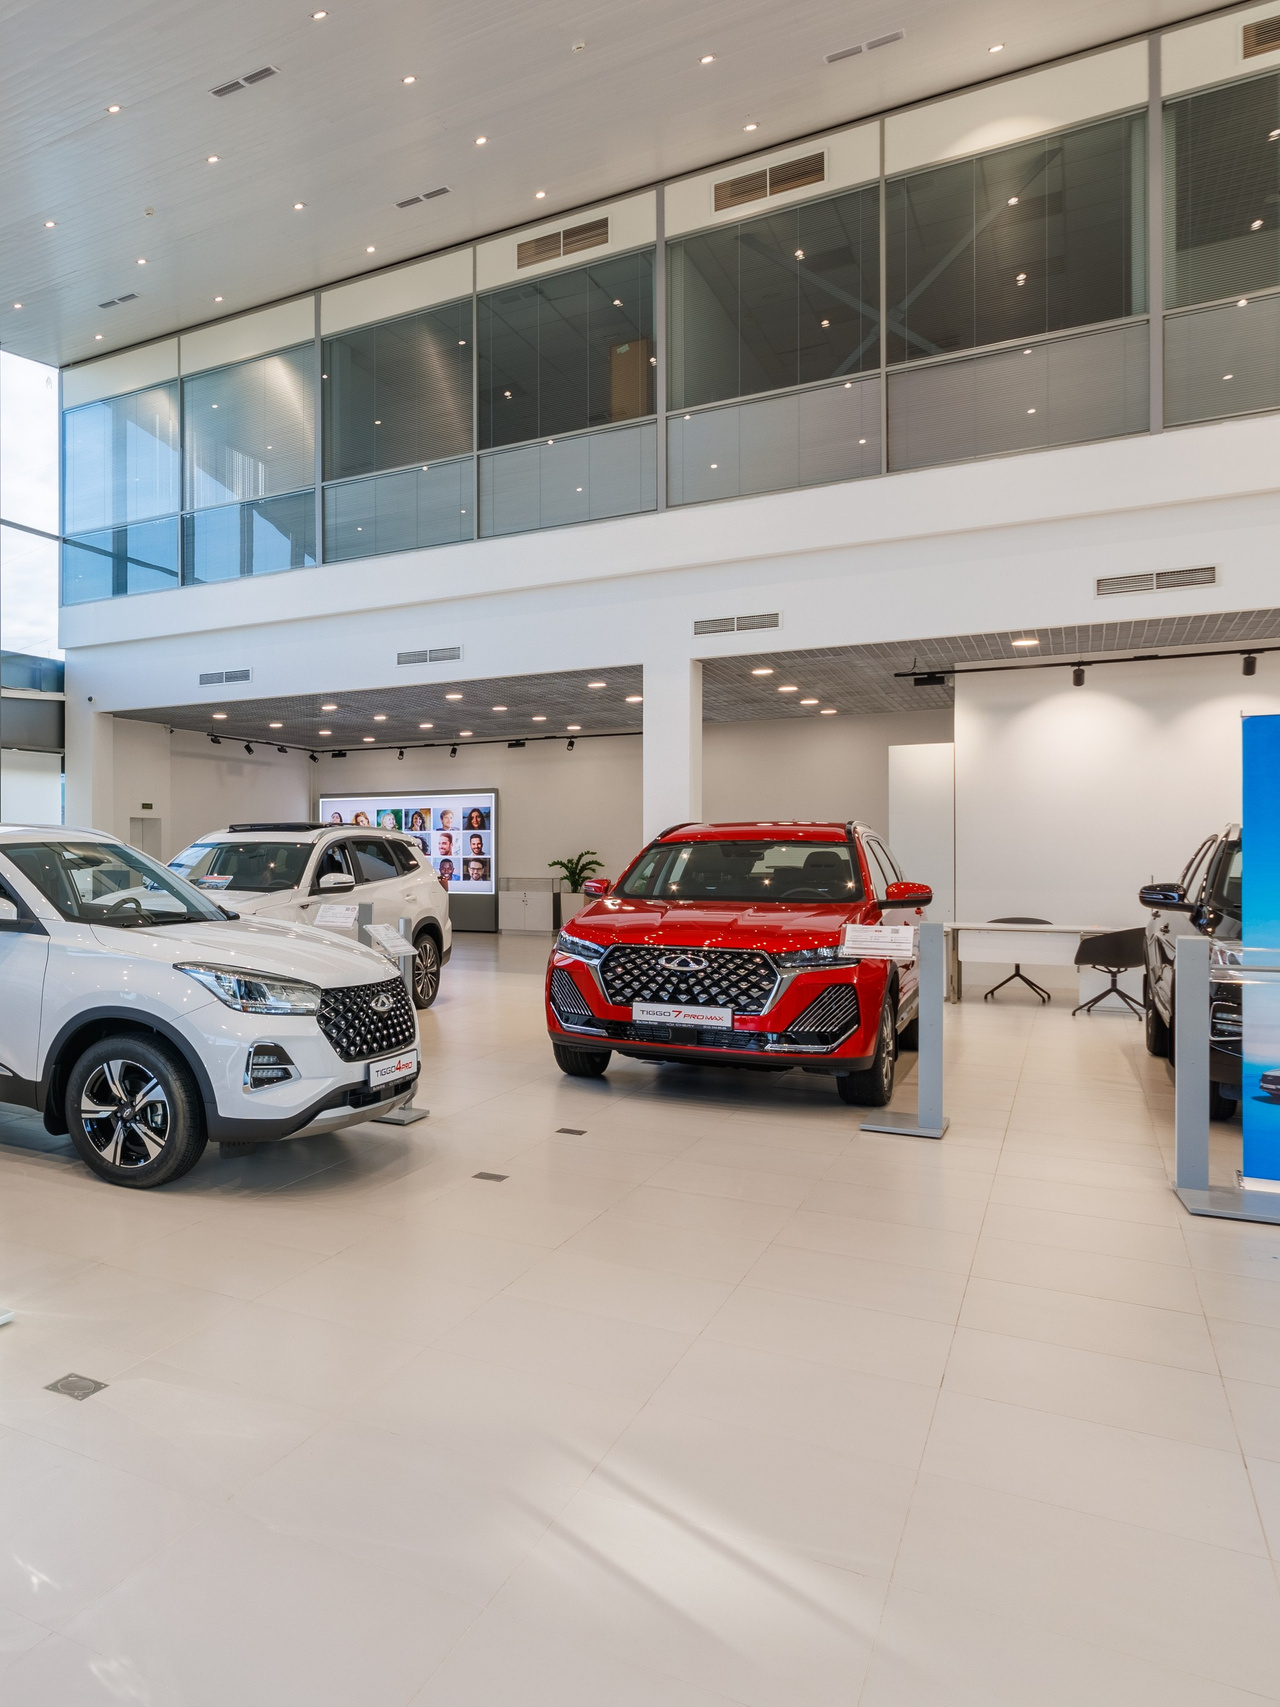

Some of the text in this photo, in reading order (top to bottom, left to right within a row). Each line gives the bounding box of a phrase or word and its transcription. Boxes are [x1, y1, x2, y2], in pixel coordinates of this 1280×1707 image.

[640, 1009, 671, 1017] TIGGO
[672, 1010, 683, 1019] 7
[683, 1013, 705, 1021] PRO
[375, 1066, 395, 1077] TIGGO
[395, 1060, 402, 1072] 4
[402, 1061, 412, 1070] PRO
